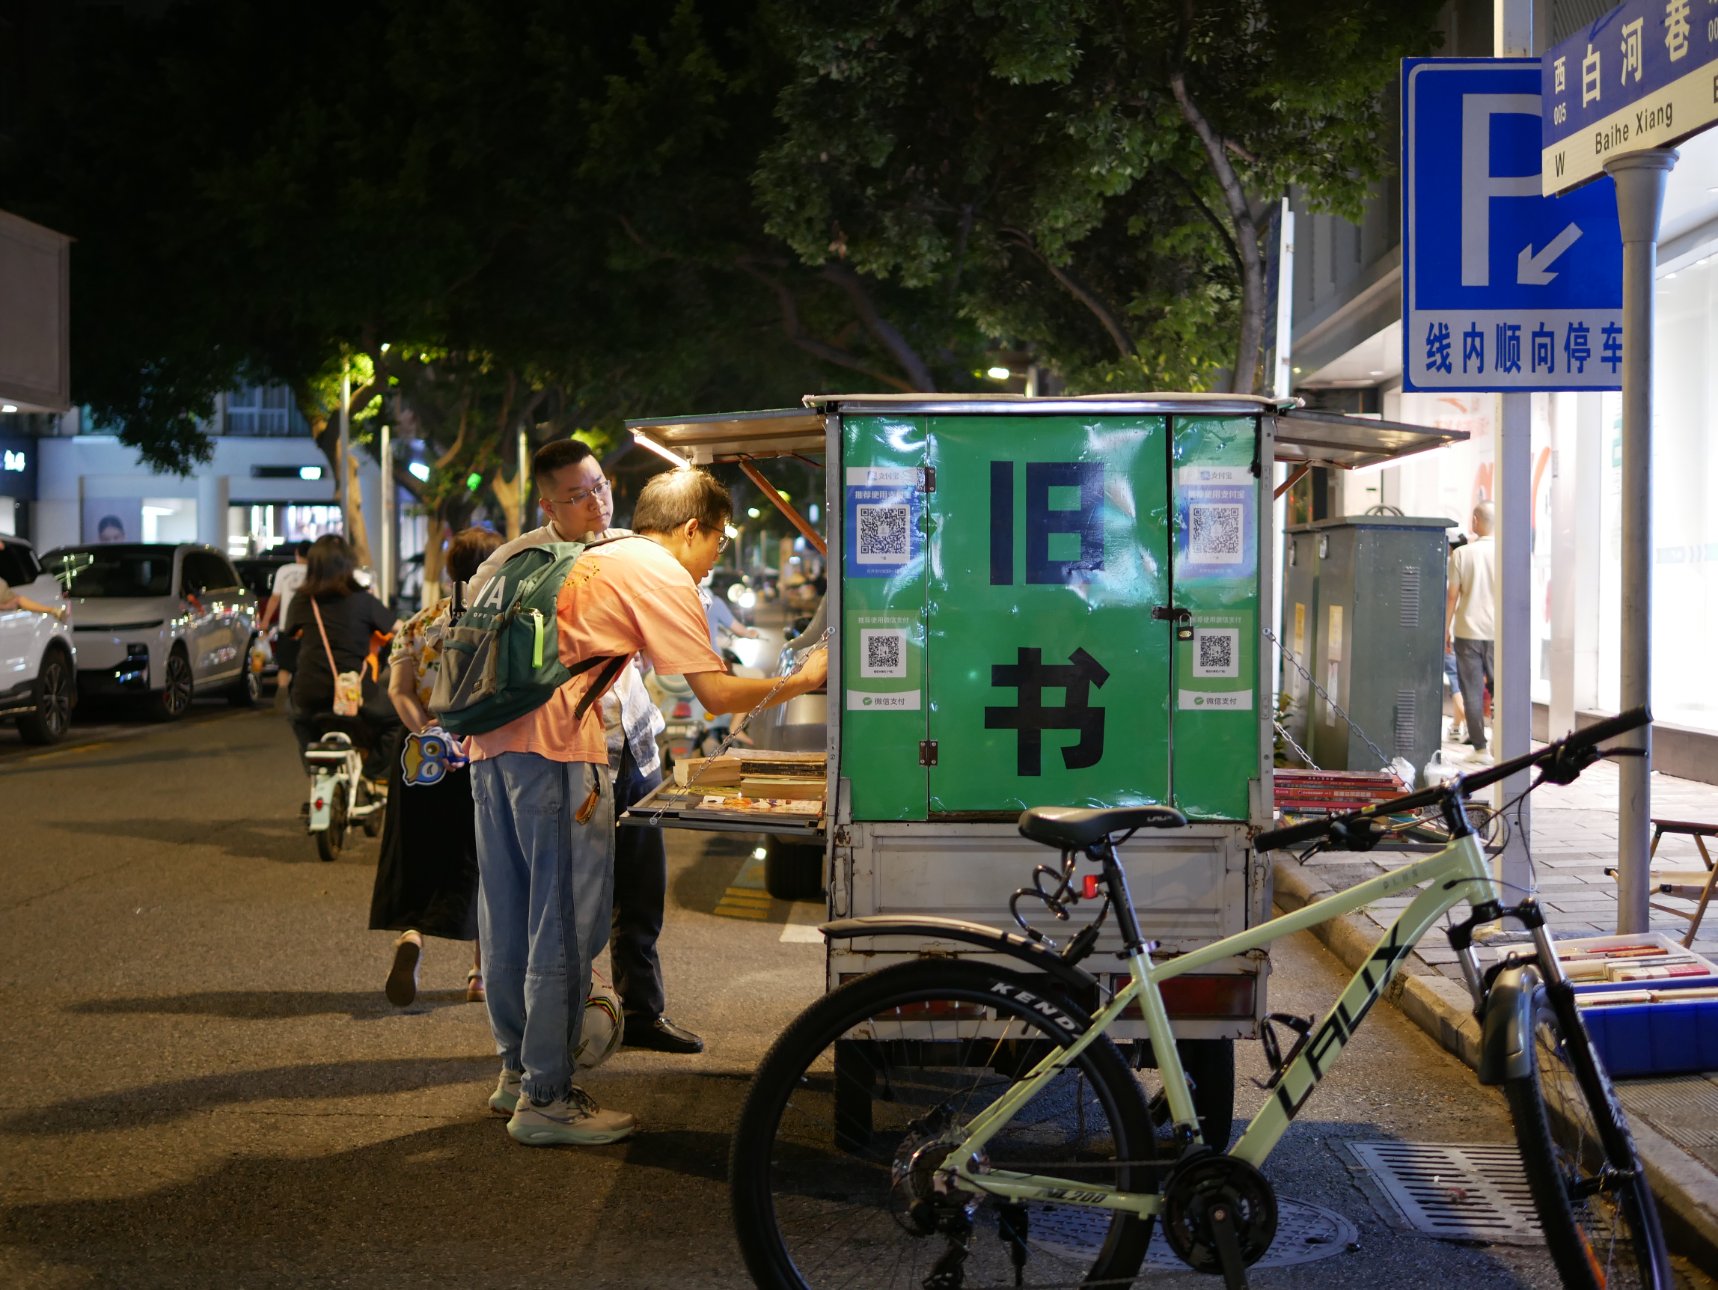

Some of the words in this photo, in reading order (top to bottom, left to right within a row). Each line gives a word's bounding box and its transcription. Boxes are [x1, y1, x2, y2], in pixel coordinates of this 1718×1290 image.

[1554, 56, 1566, 94] 西
[1582, 0, 1690, 108] 白河巷
[1595, 123, 1629, 154] Baihe
[1636, 102, 1673, 136] Xiang
[1425, 321, 1623, 375] 线内顺向停车
[984, 461, 1110, 776] 旧书
[874, 697, 905, 706] 微信支付
[1206, 697, 1237, 706] 微信支付
[990, 982, 1081, 1039] KEND
